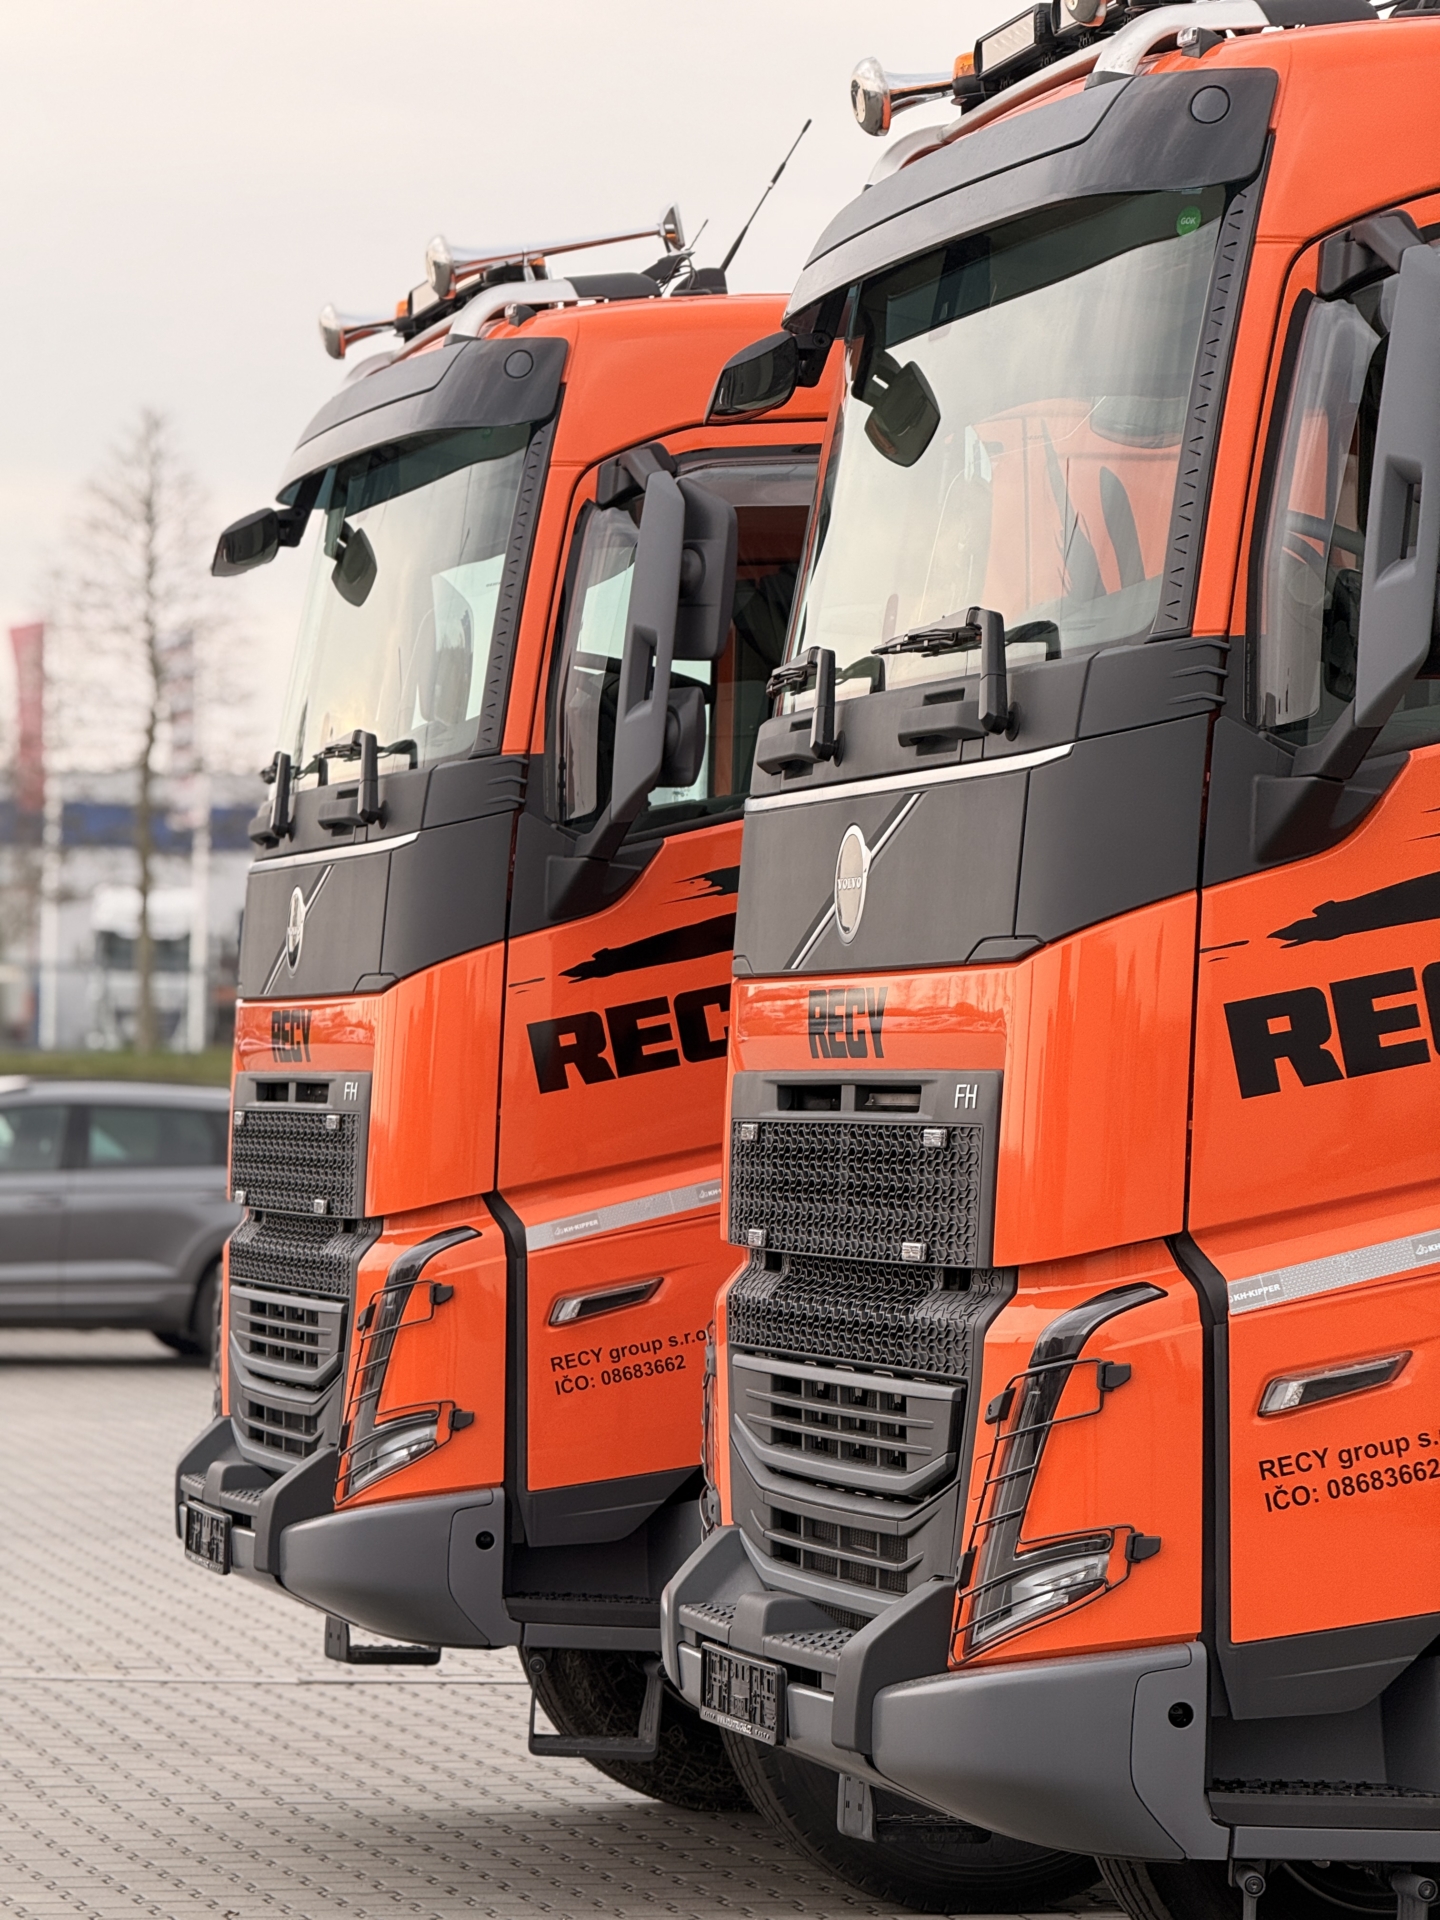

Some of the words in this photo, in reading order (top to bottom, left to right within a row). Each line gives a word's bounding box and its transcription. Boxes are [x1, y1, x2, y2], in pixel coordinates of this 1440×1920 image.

[1180, 217, 1197, 225] GOK
[838, 877, 862, 890] VOLVO
[271, 1009, 312, 1063] RECY
[808, 987, 888, 1059] RECY
[1223, 961, 1440, 1099] RE
[343, 1082, 358, 1101] FH
[954, 1084, 978, 1109] FH
[563, 1219, 598, 1233] KH-KIPPER
[1233, 1283, 1281, 1302] KH-KIPPER
[550, 1347, 602, 1372] RECY
[609, 1339, 663, 1364] group
[555, 1375, 596, 1395] IČO:
[601, 1355, 686, 1385] 08683662
[1258, 1447, 1329, 1481] RECY
[1338, 1436, 1410, 1470] group
[1417, 1430, 1440, 1448] s.
[1265, 1485, 1319, 1512] IČO:
[1327, 1458, 1440, 1499] 08683662
